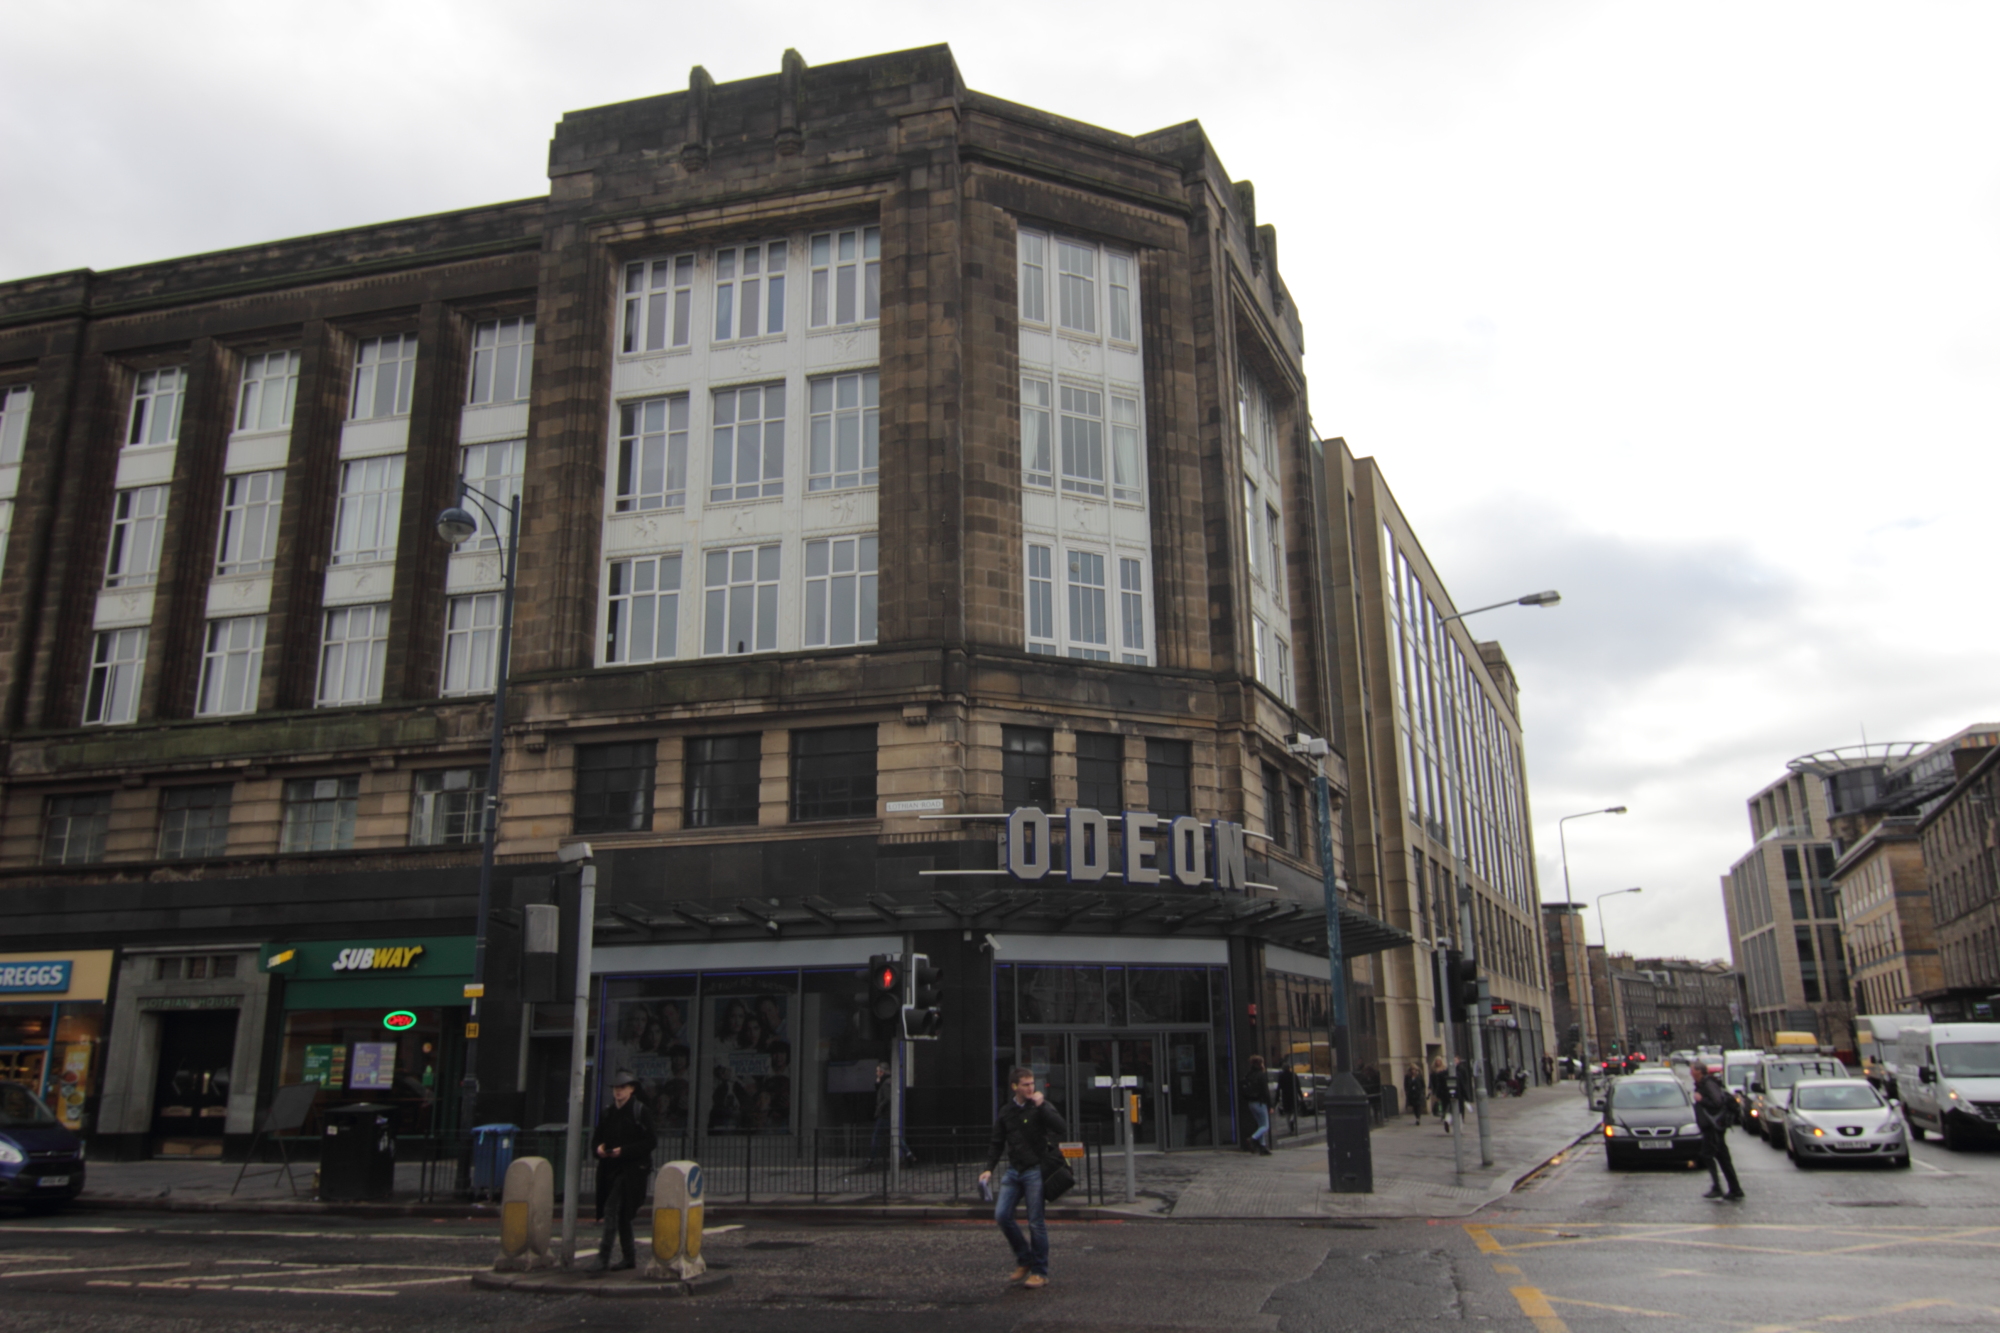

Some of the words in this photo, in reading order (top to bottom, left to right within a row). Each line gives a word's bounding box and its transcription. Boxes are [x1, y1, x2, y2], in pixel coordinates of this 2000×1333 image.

[888, 802, 919, 810] LOTHIAN
[921, 800, 941, 808] ROAD
[1006, 806, 1246, 891] ODEON
[332, 945, 423, 970] SUBWAY
[144, 998, 190, 1009] LOTHIAN
[199, 997, 237, 1008] HOUSE
[388, 1015, 413, 1026] OPEN
[468, 1025, 478, 1036] H
